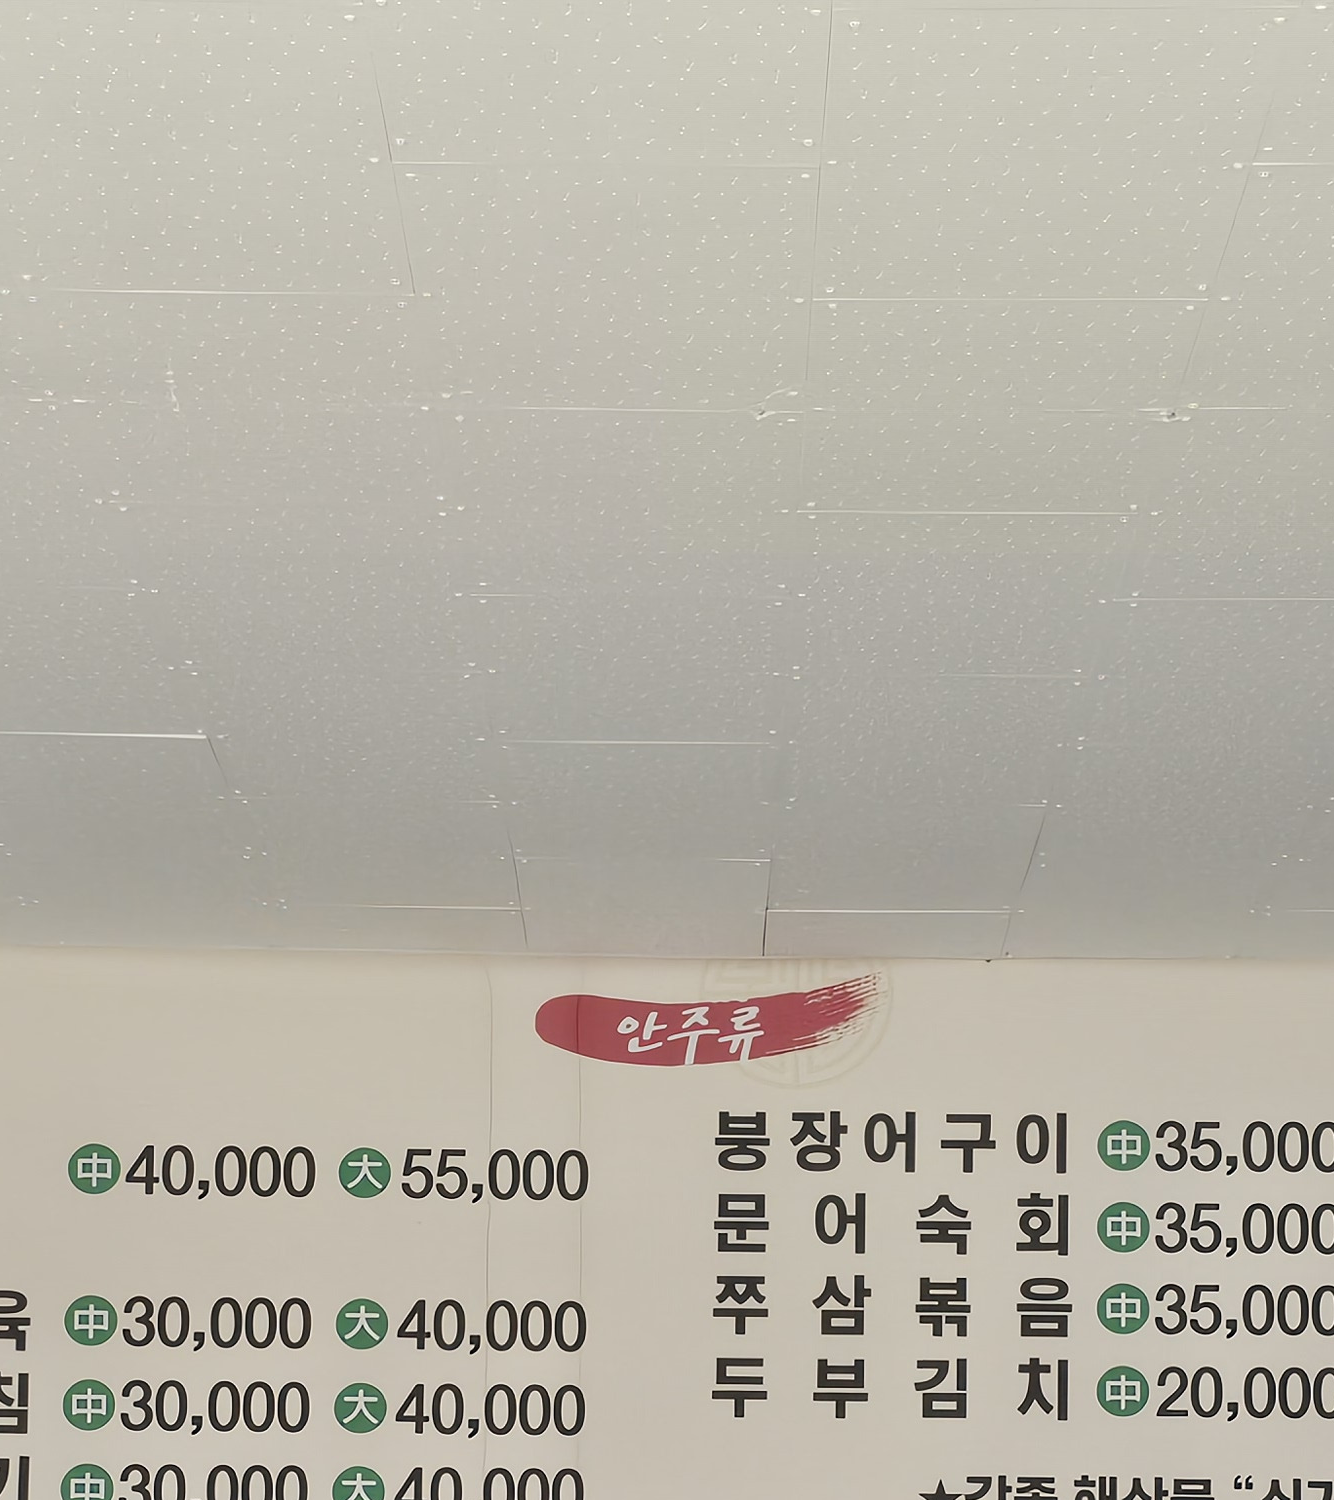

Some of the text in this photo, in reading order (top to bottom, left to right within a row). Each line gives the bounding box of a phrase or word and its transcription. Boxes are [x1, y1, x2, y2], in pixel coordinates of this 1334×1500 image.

[616, 1008, 767, 1063] 안주류
[714, 1110, 1067, 1174] 붕장어구이
[124, 1144, 316, 1200] 40,000
[401, 1148, 589, 1204] 55,000
[122, 1295, 312, 1352] 30,000
[396, 1299, 587, 1355] 40,000
[120, 1379, 310, 1436] 30,000
[395, 1383, 586, 1439] 40,000
